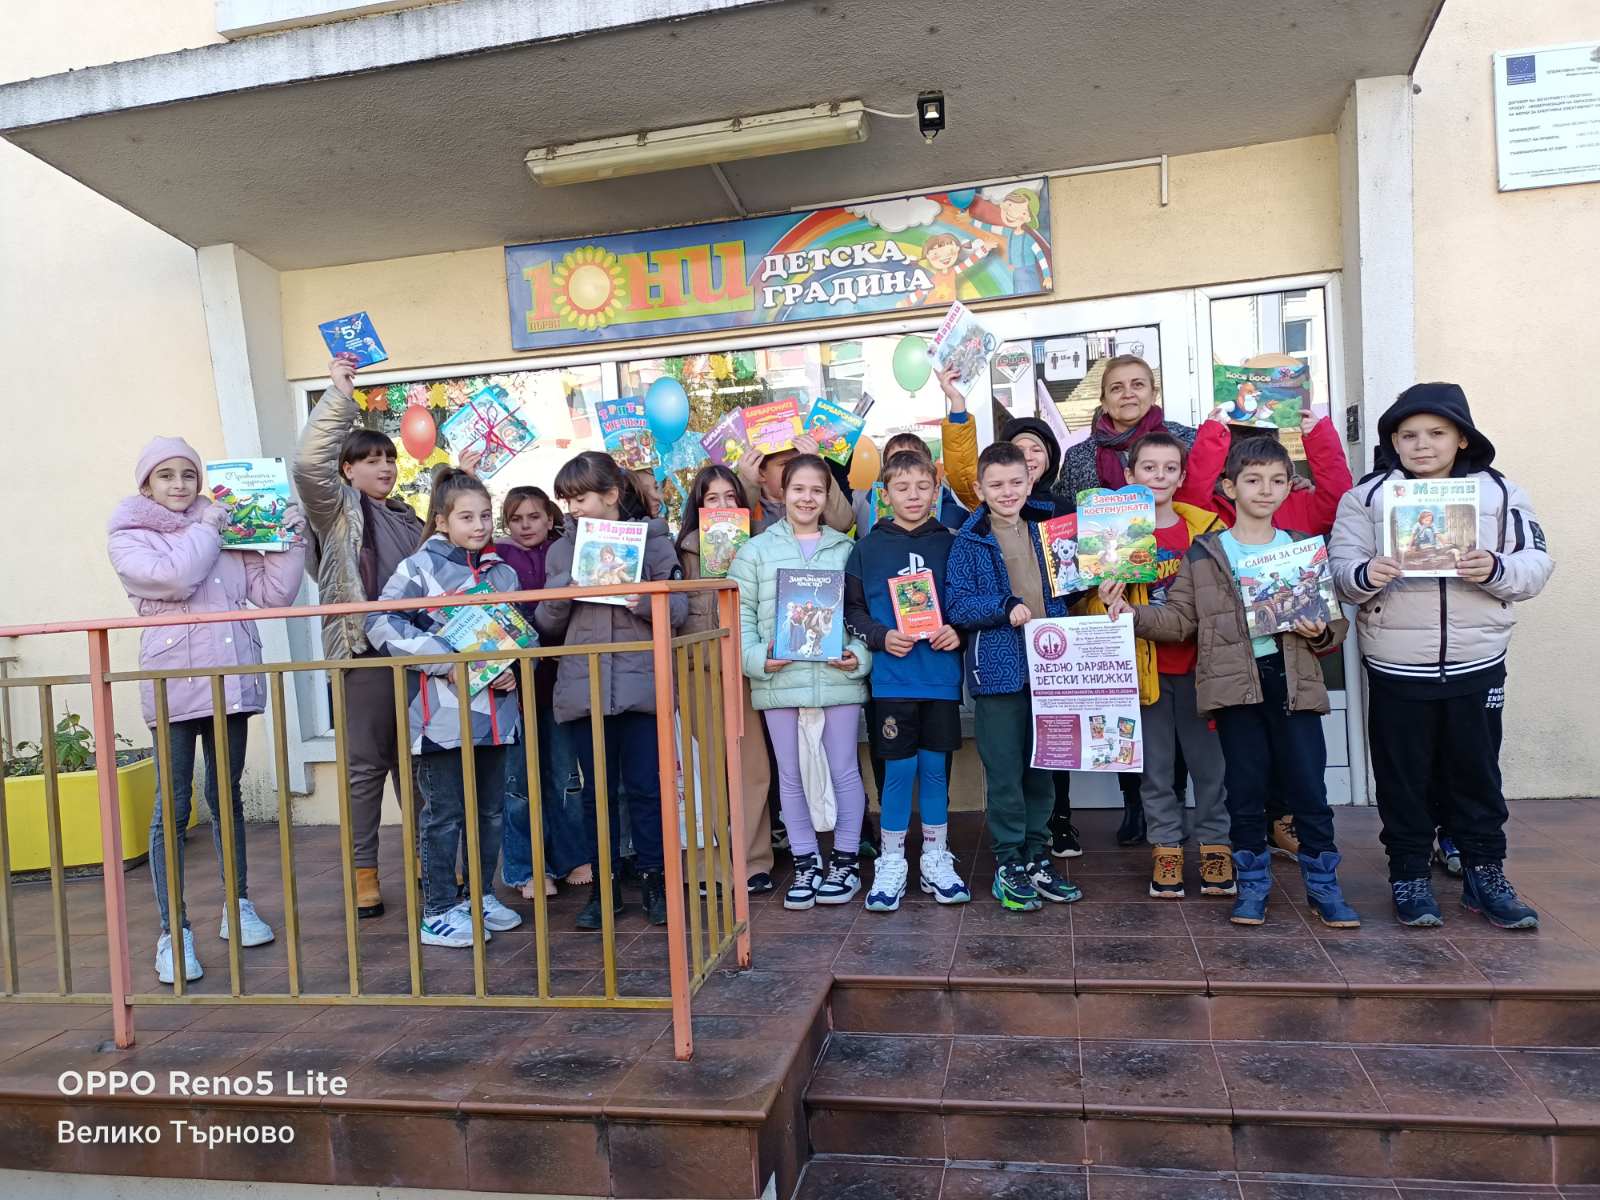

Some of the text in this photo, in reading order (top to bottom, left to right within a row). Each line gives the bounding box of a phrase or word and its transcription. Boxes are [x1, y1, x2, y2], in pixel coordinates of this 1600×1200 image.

[760, 240, 907, 281] ДЕТСКА
[762, 269, 934, 309] ГРАДИНА
[1084, 504, 1149, 515] костенурката
[1244, 543, 1318, 569] СЛИВИ ЗА СМЕТ
[1034, 660, 1134, 673] ЗАЕДНО ДАРЯВАМЕ
[1036, 673, 1133, 686] ДЕТСКИ КНИЖКИ
